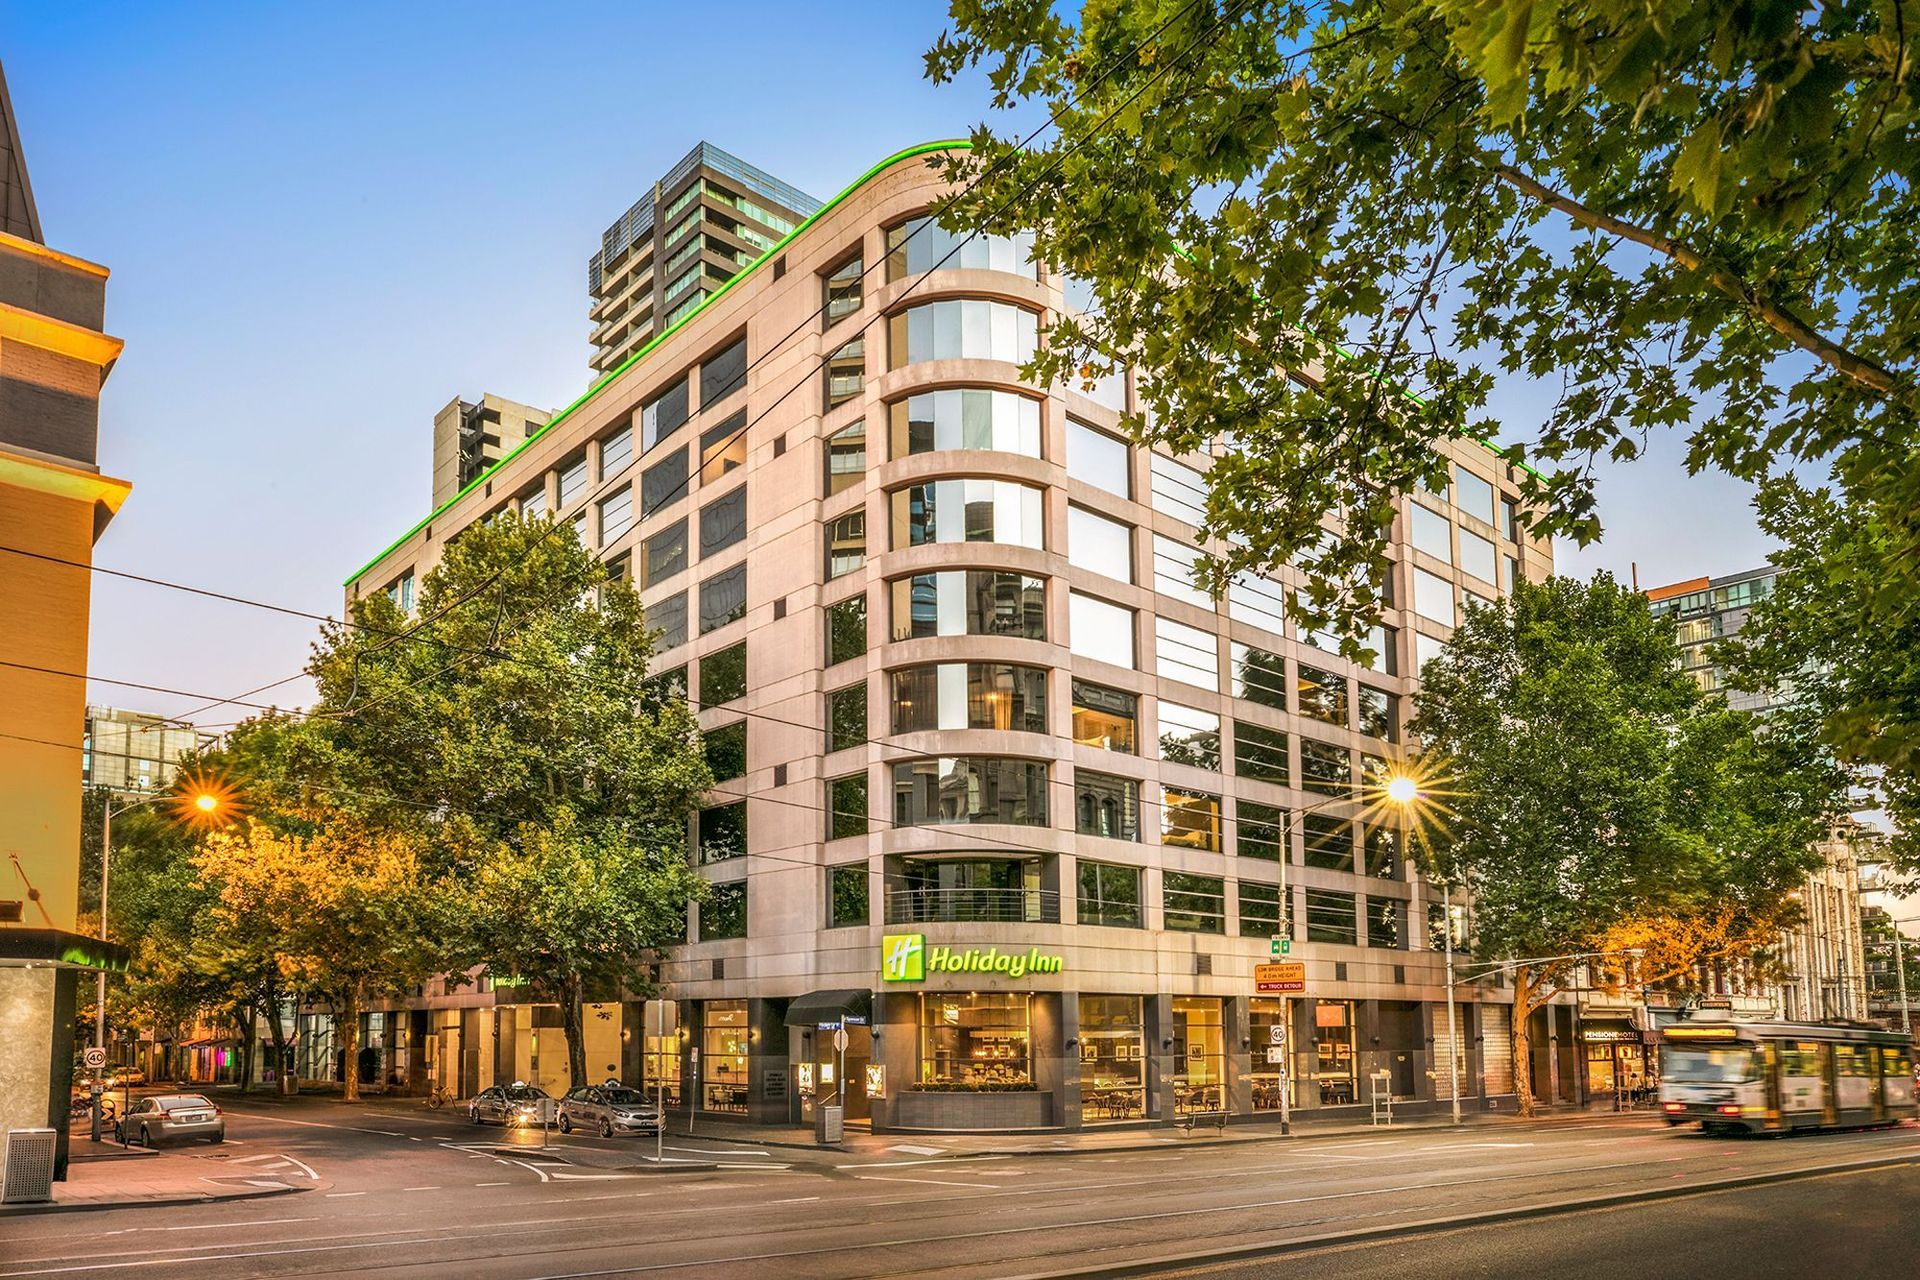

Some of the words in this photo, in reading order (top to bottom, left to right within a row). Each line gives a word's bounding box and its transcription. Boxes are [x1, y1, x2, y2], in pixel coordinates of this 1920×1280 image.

[929, 948, 1026, 977] Holiday
[1029, 948, 1063, 972] Inn
[1273, 1030, 1283, 1039] 40
[90, 1054, 103, 1062] 40
